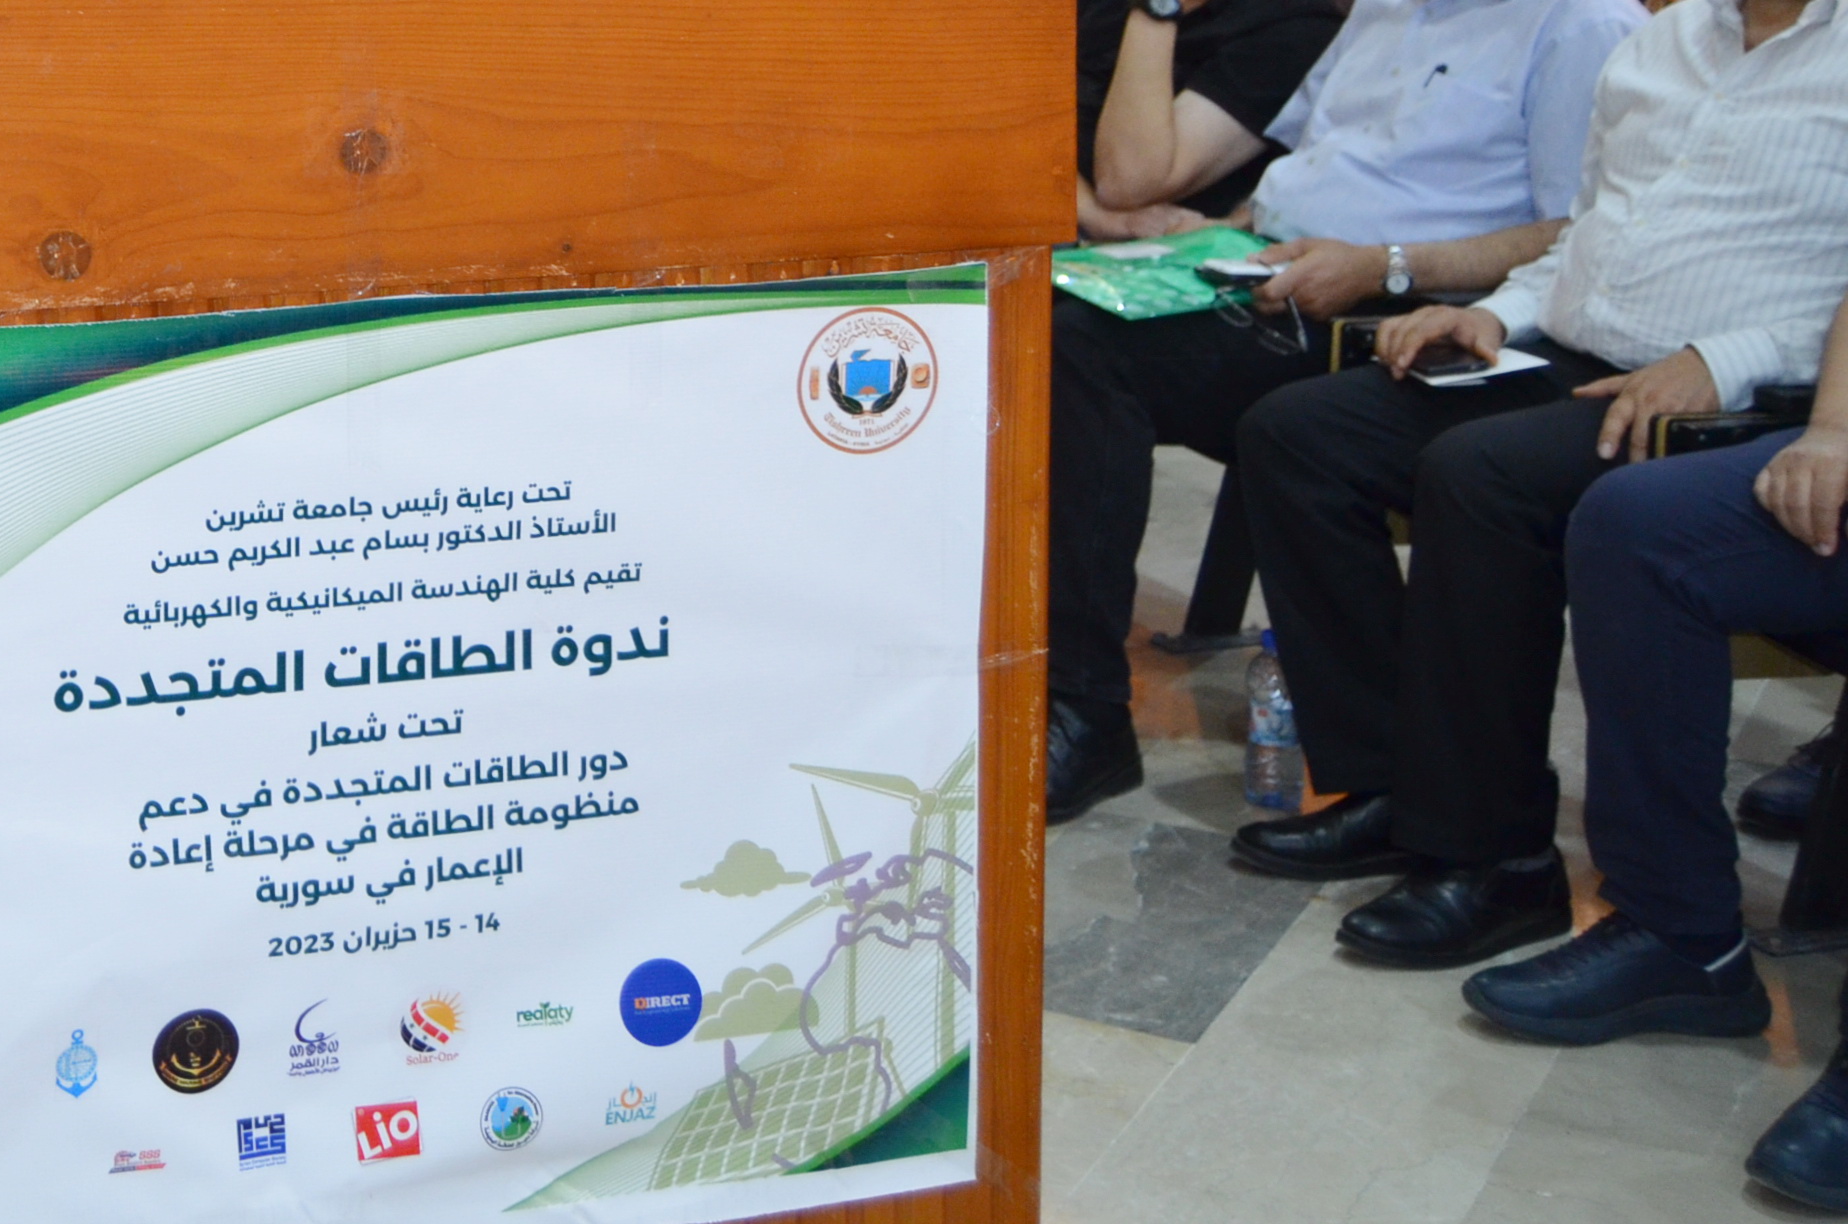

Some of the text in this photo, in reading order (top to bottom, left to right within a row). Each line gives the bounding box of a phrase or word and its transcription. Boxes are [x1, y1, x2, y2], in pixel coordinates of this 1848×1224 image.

[205, 480, 572, 533] تحت رعاية رئيس جامعة تشرين
[151, 509, 617, 574] الأستاذ الدكتور بسام عبد الكريم حسن
[123, 562, 643, 630] تقيم كلية الهندسة الميكانيكية والكهربائية
[53, 615, 669, 717] ندوة الطاقات المتجددة
[308, 709, 464, 756] تحت شعار
[138, 750, 629, 832] دور الطاقات المتجددة في دعم
[128, 790, 640, 873] منظومة الطاقة في مرحلة إعادة
[255, 846, 523, 909] الإعمار في سورية
[268, 931, 335, 958] 2023
[343, 922, 417, 953] حزيران
[424, 917, 452, 940] 15
[474, 912, 501, 934] 14
[634, 993, 691, 1010] DIRECT
[605, 1107, 656, 1126] ENJAZ
